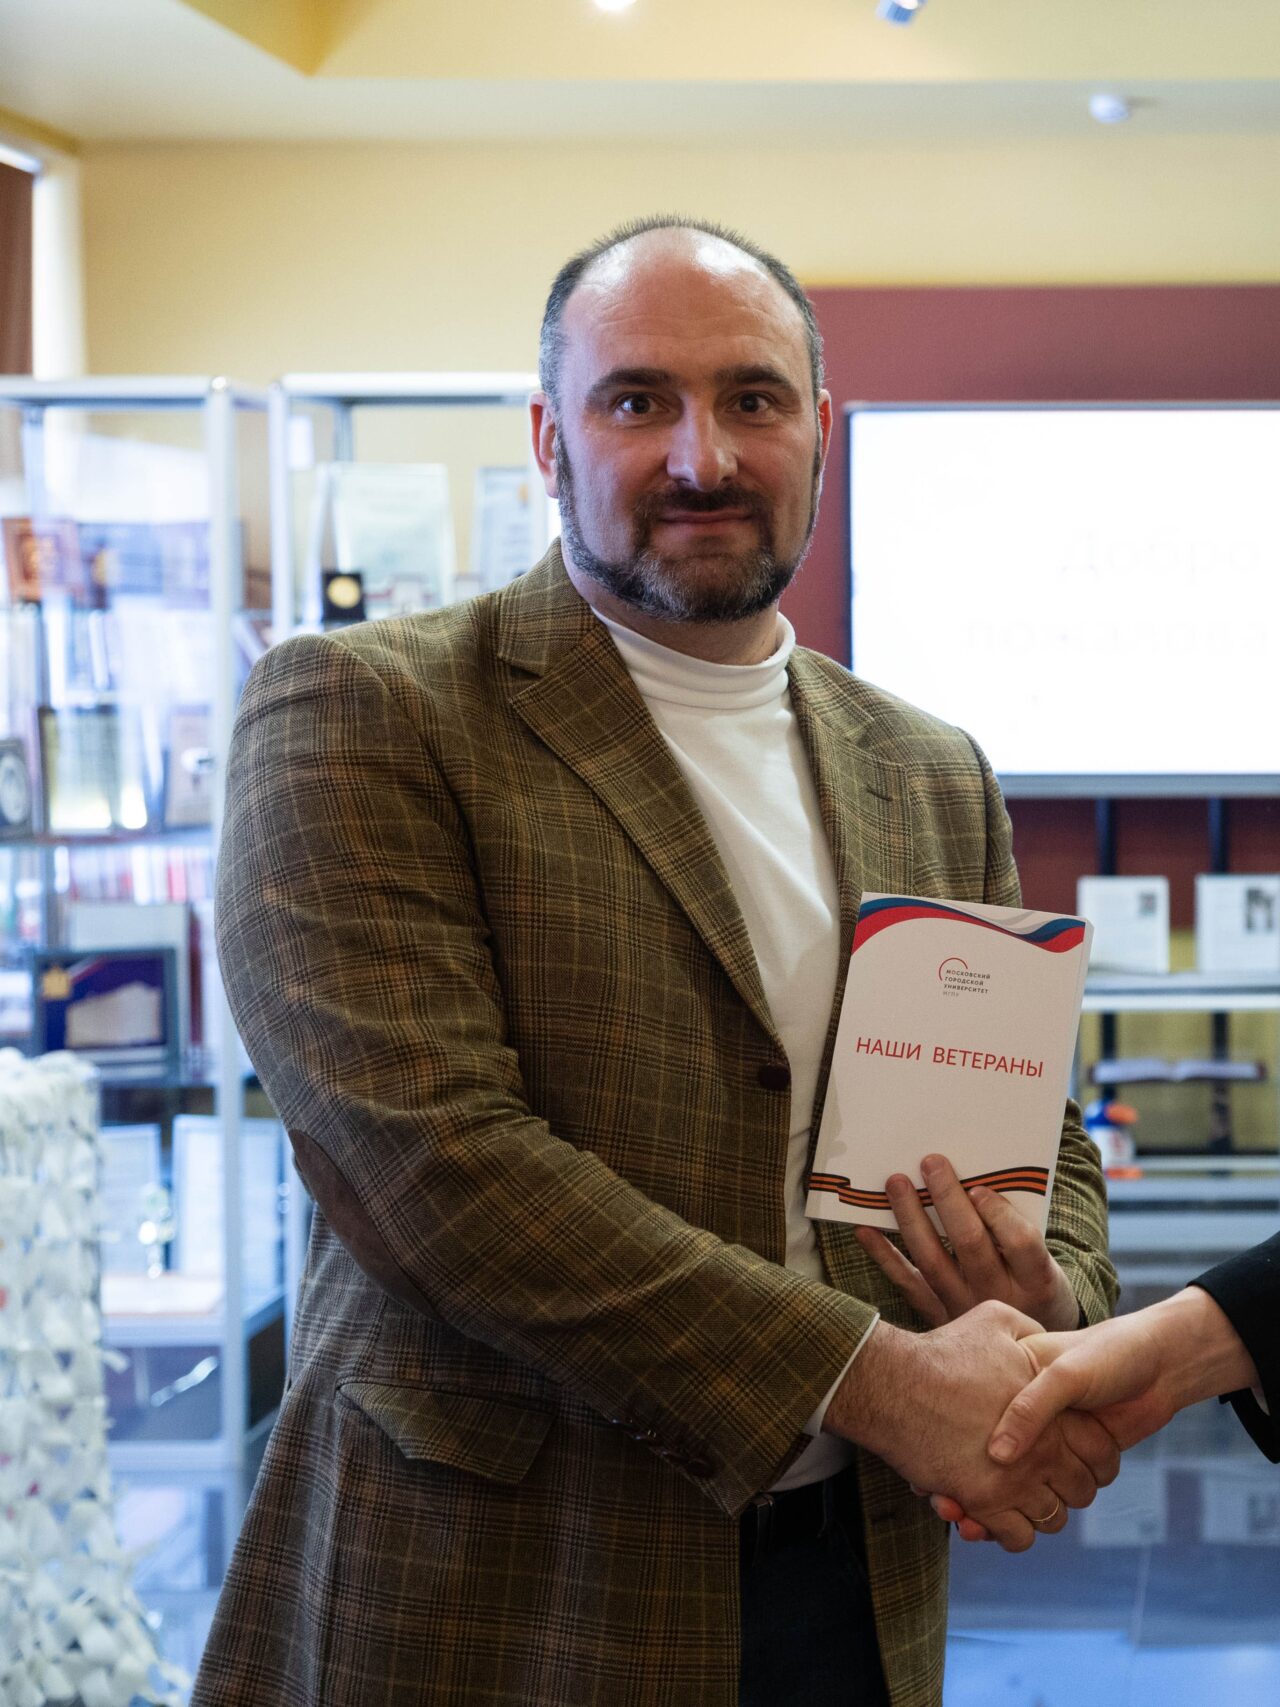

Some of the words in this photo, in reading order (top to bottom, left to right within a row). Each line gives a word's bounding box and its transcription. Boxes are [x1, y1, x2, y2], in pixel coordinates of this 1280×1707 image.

[944, 976, 984, 986] ГОРОДСКОЙ
[943, 984, 988, 994] УНИВЕРСИТЕТ
[856, 1037, 921, 1061] НАШИ
[932, 1046, 1044, 1078] ВЕТЕРАНЫ
